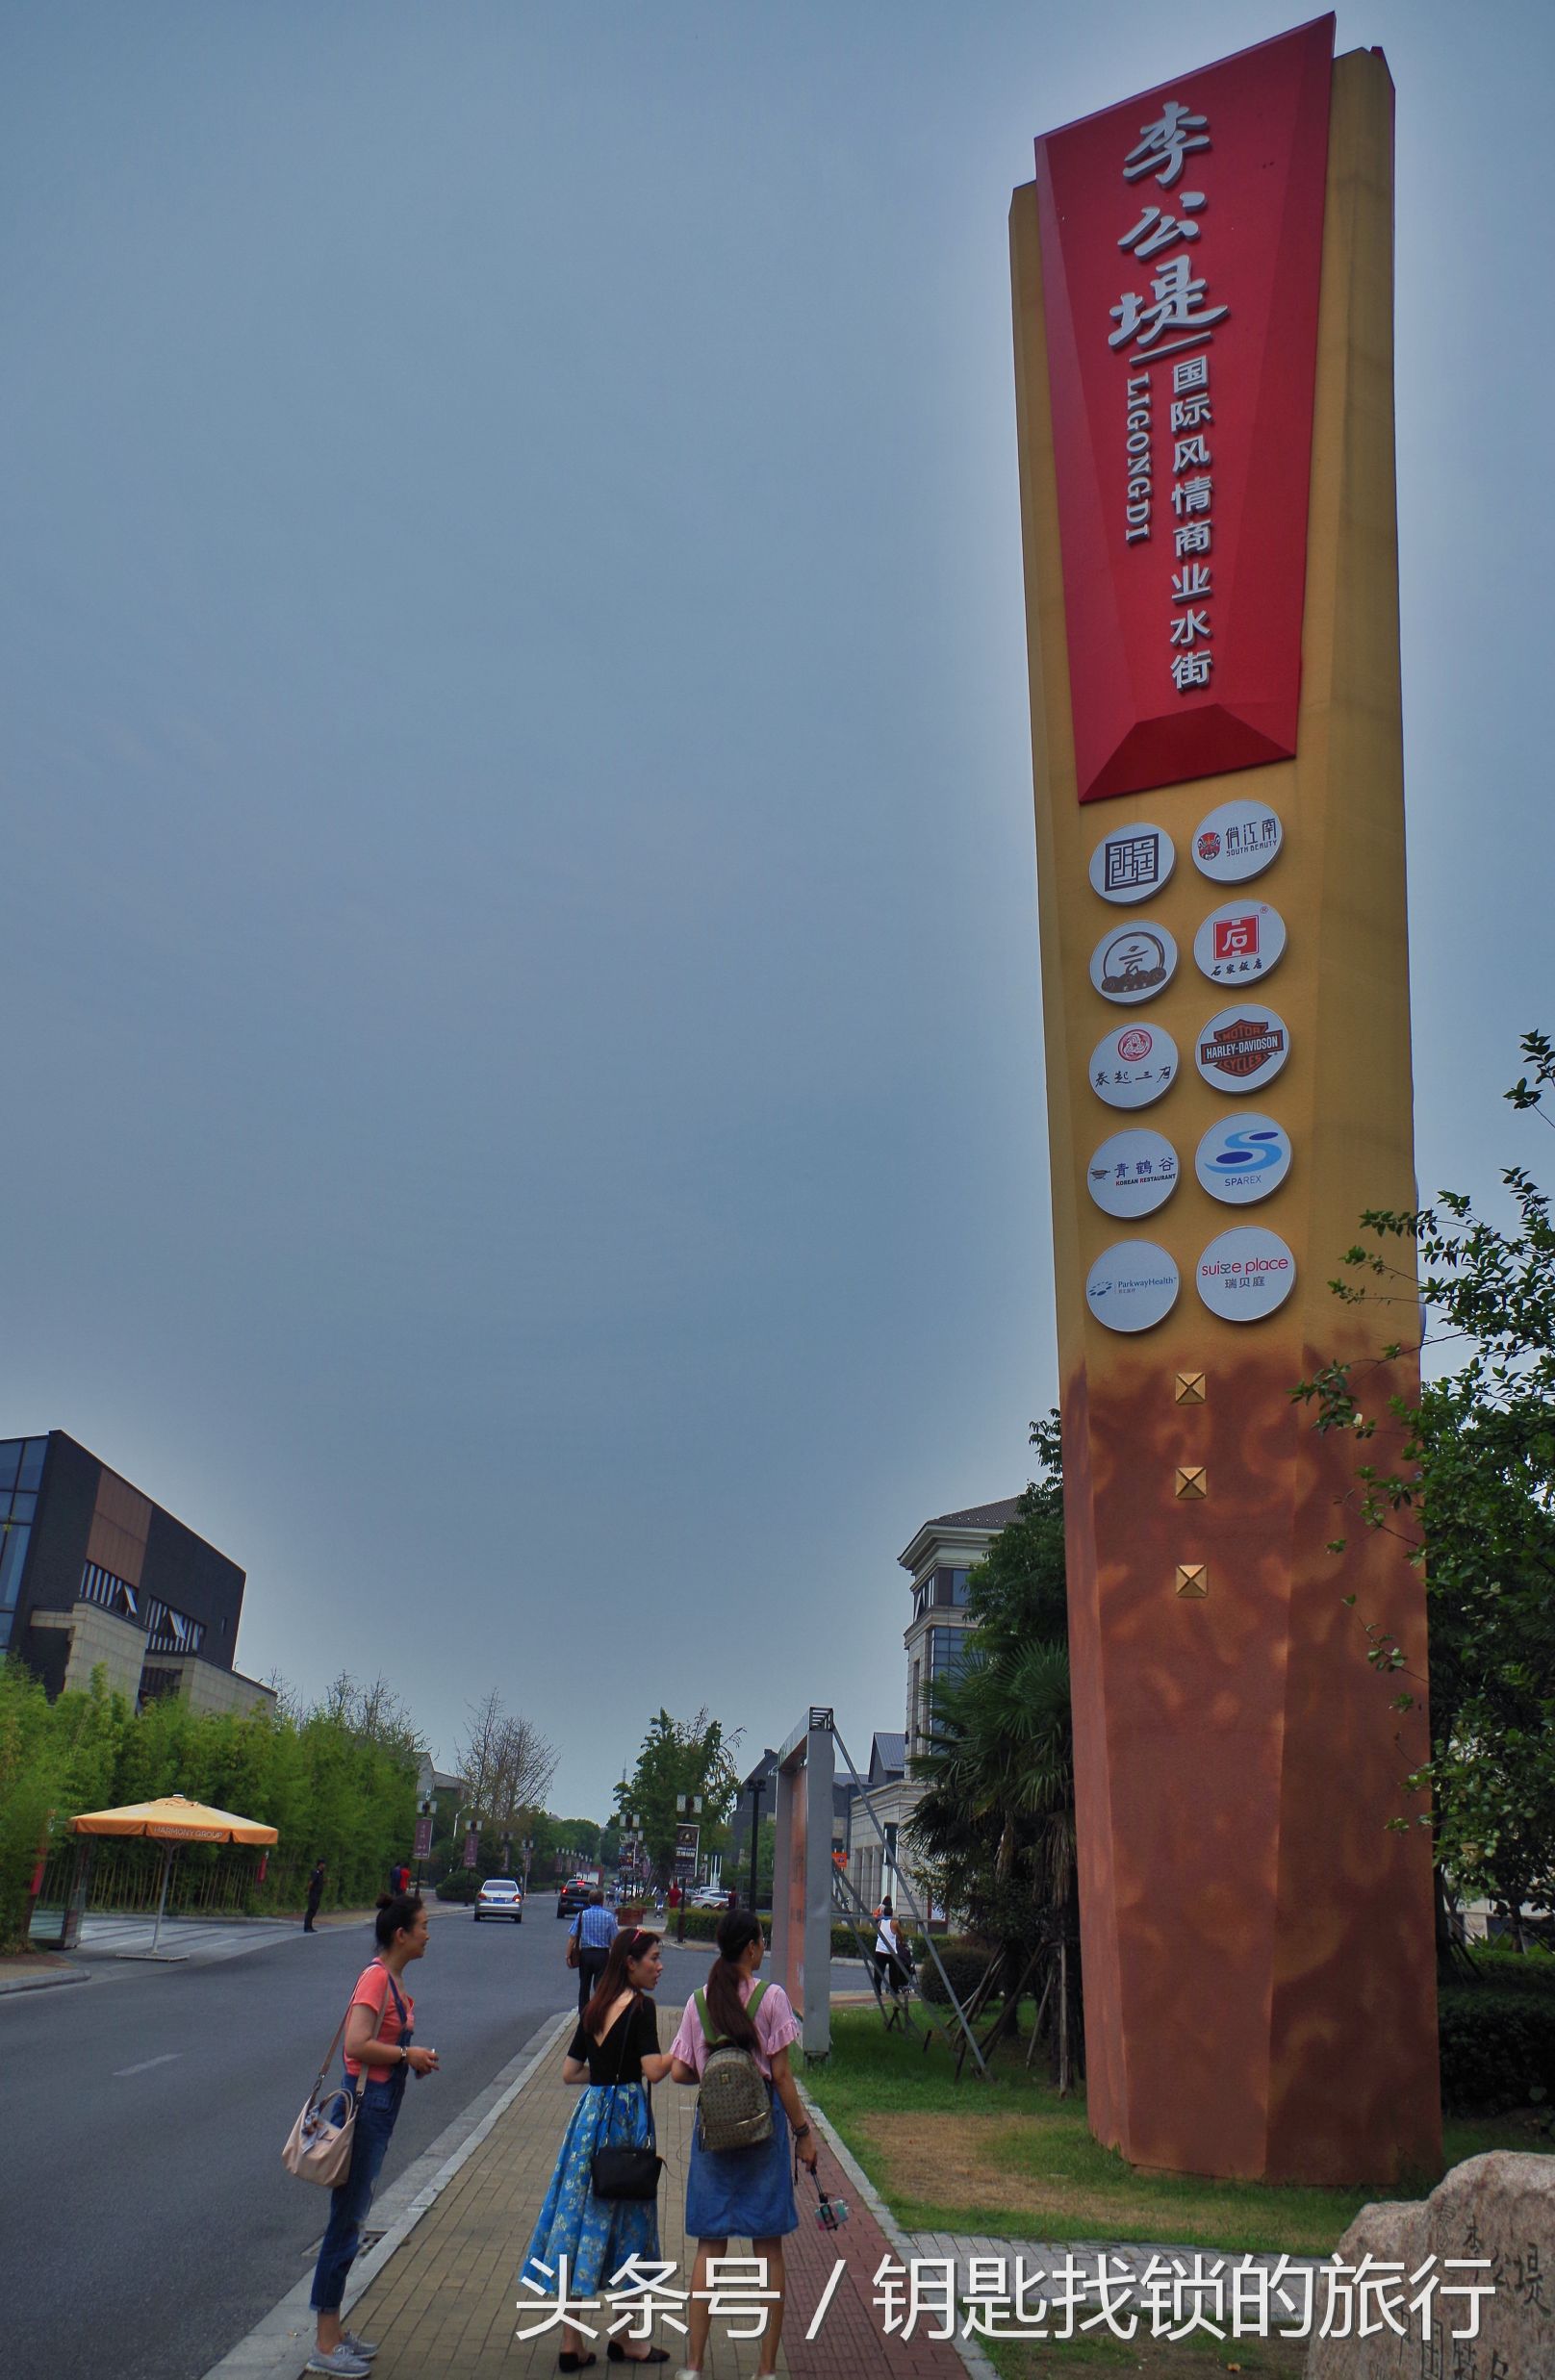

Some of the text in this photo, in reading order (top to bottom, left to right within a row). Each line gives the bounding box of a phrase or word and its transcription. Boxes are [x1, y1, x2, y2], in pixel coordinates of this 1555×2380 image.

[1108, 100, 1232, 350] 李公堤
[1125, 371, 1153, 545] LIGONGDI
[1169, 355, 1214, 693] 国际风情商业水街
[1225, 818, 1277, 850] 俏江南
[1226, 848, 1249, 857] SOUTH
[1222, 1025, 1262, 1040] MOTOR
[1206, 1035, 1279, 1060] HARLEY-DAVIDSON
[1223, 1054, 1262, 1073] CYCLES
[1115, 1173, 1177, 1186] KOREAN RESTAURANT
[1224, 1175, 1262, 1187] SPAREX
[1245, 1257, 1289, 1276] place
[1224, 1276, 1266, 1289] 瑞贝庭
[154, 1826, 223, 1839] HARMONY GROUP
